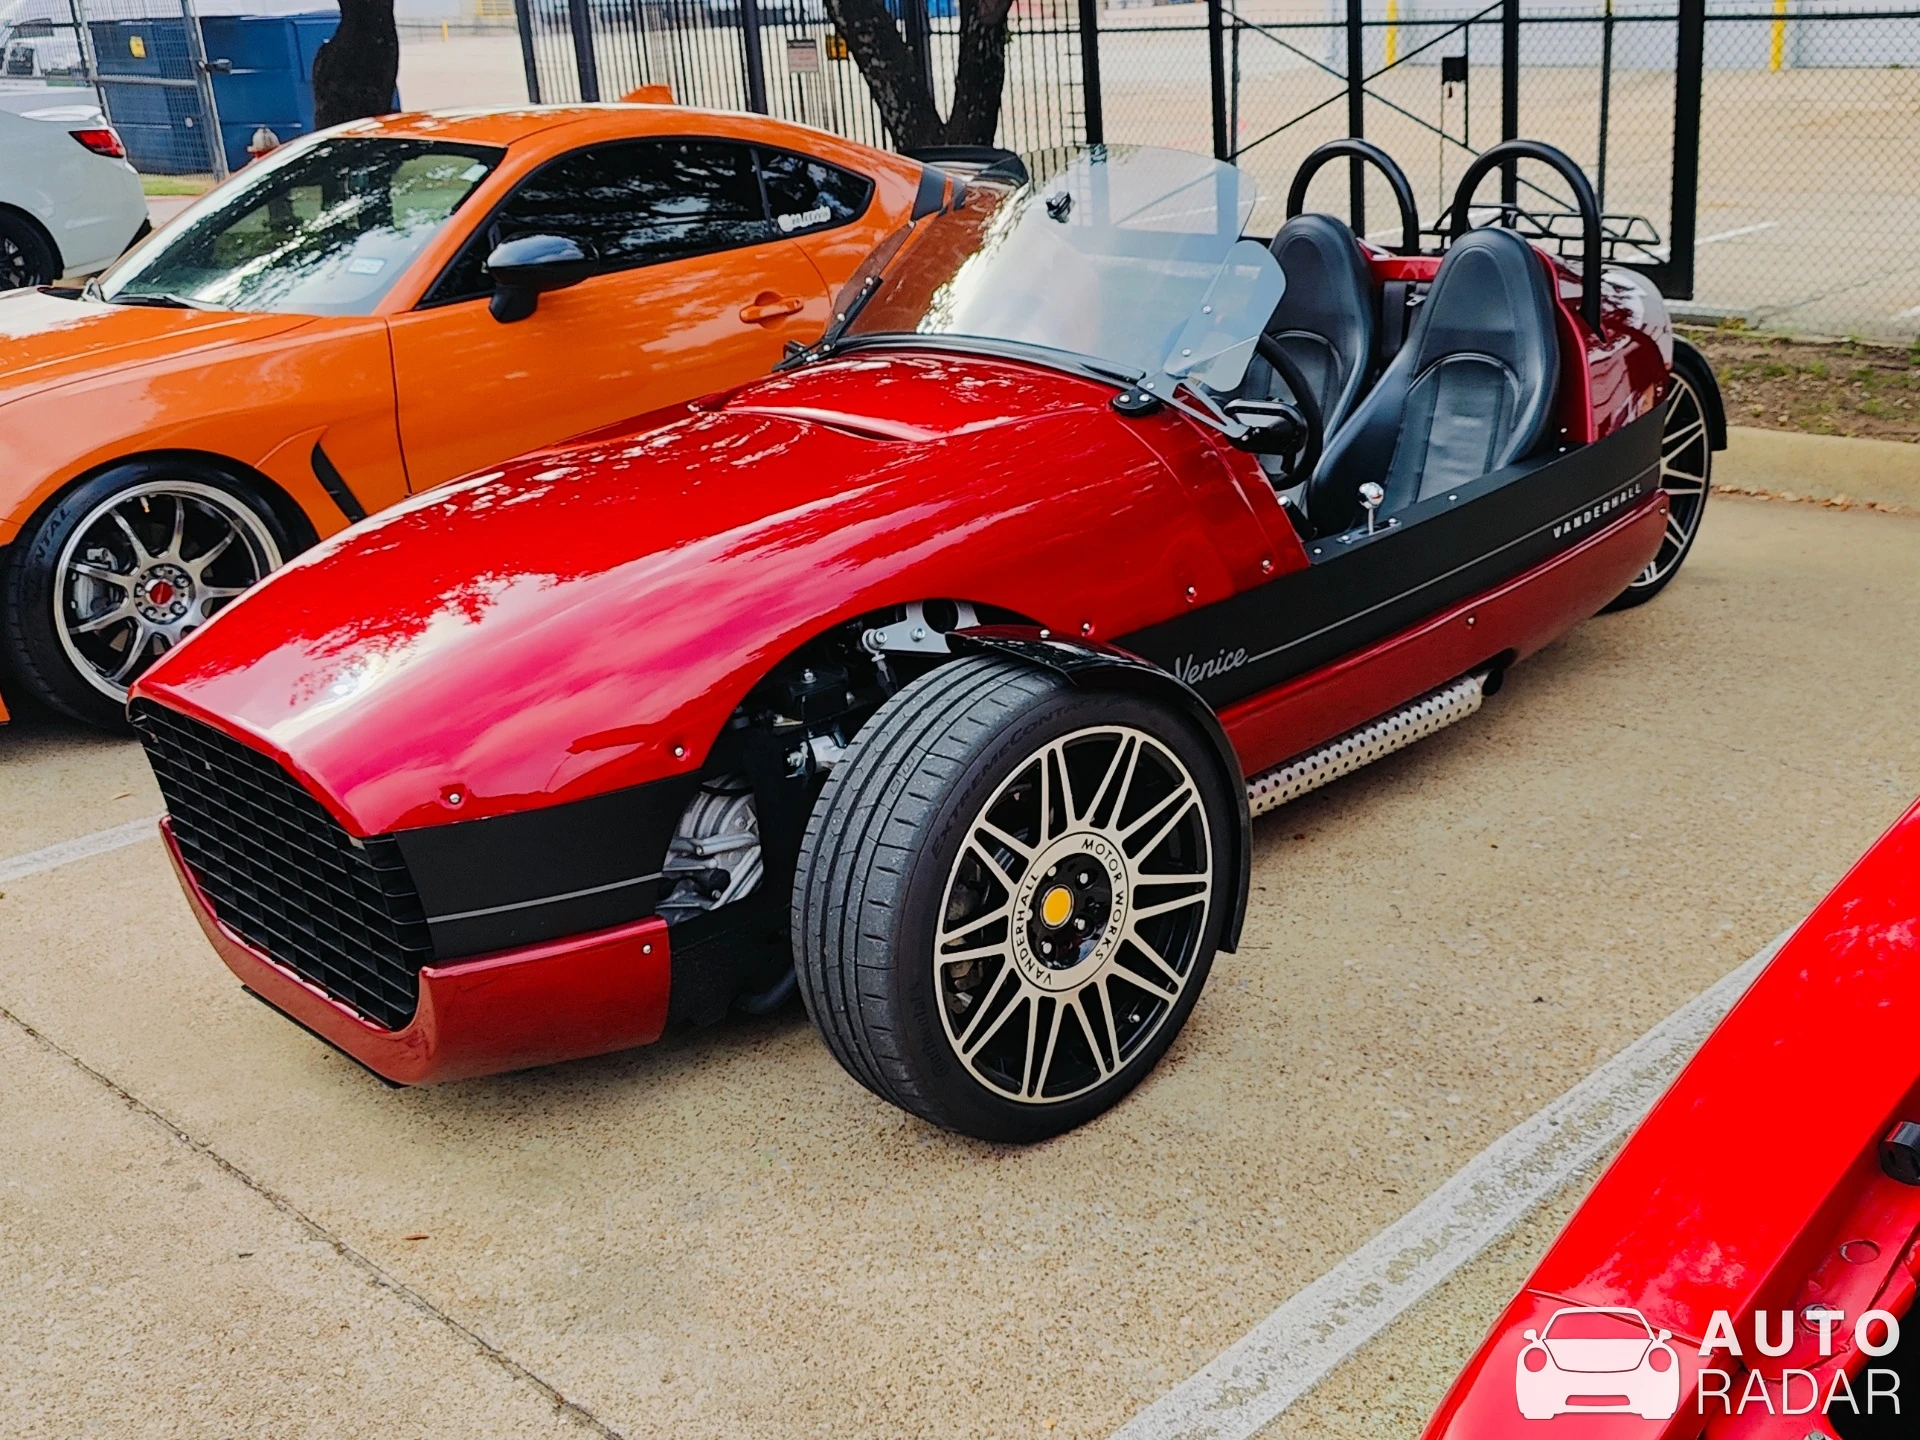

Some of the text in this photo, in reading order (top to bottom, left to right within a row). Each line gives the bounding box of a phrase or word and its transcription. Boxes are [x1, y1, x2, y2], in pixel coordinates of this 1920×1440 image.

[1553, 483, 1641, 538] VANDERHALL
[1175, 647, 1248, 685] Venice
[1015, 838, 1124, 985] VANDERHALL MOTOR WORKS
